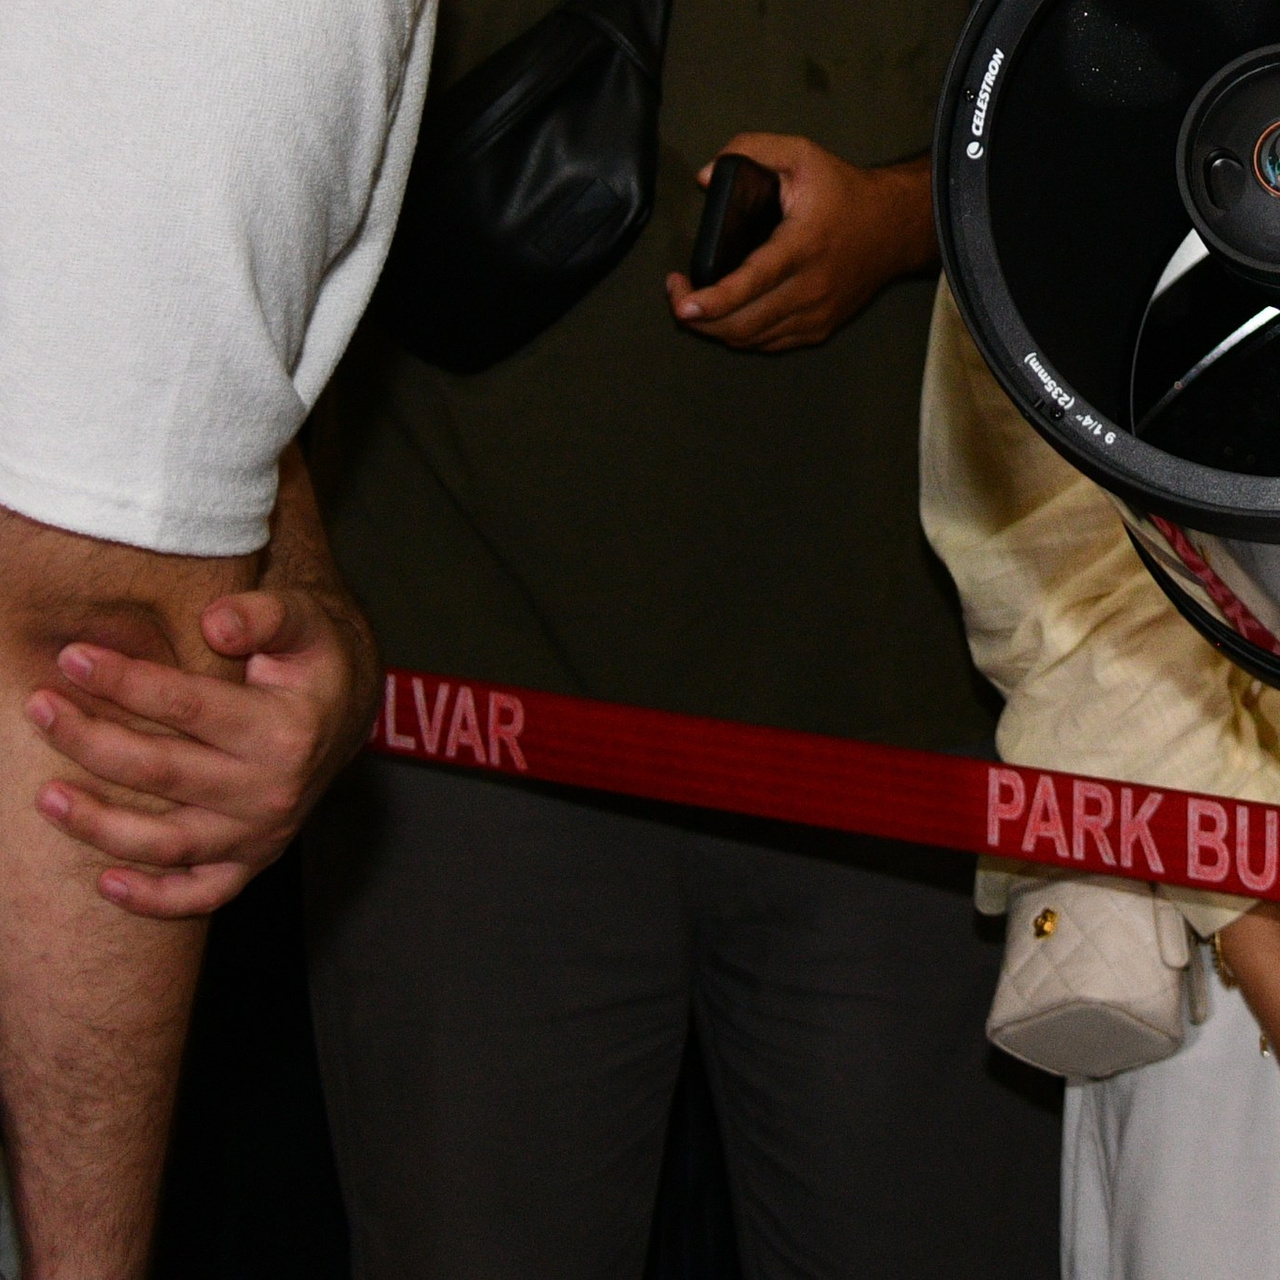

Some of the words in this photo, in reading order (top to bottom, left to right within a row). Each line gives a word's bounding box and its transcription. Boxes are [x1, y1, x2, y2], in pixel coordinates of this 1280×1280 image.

[971, 47, 1005, 137] CELESTRON
[1024, 351, 1075, 410] (235mm)
[378, 673, 529, 771] LVAR
[986, 766, 1165, 875] PARK
